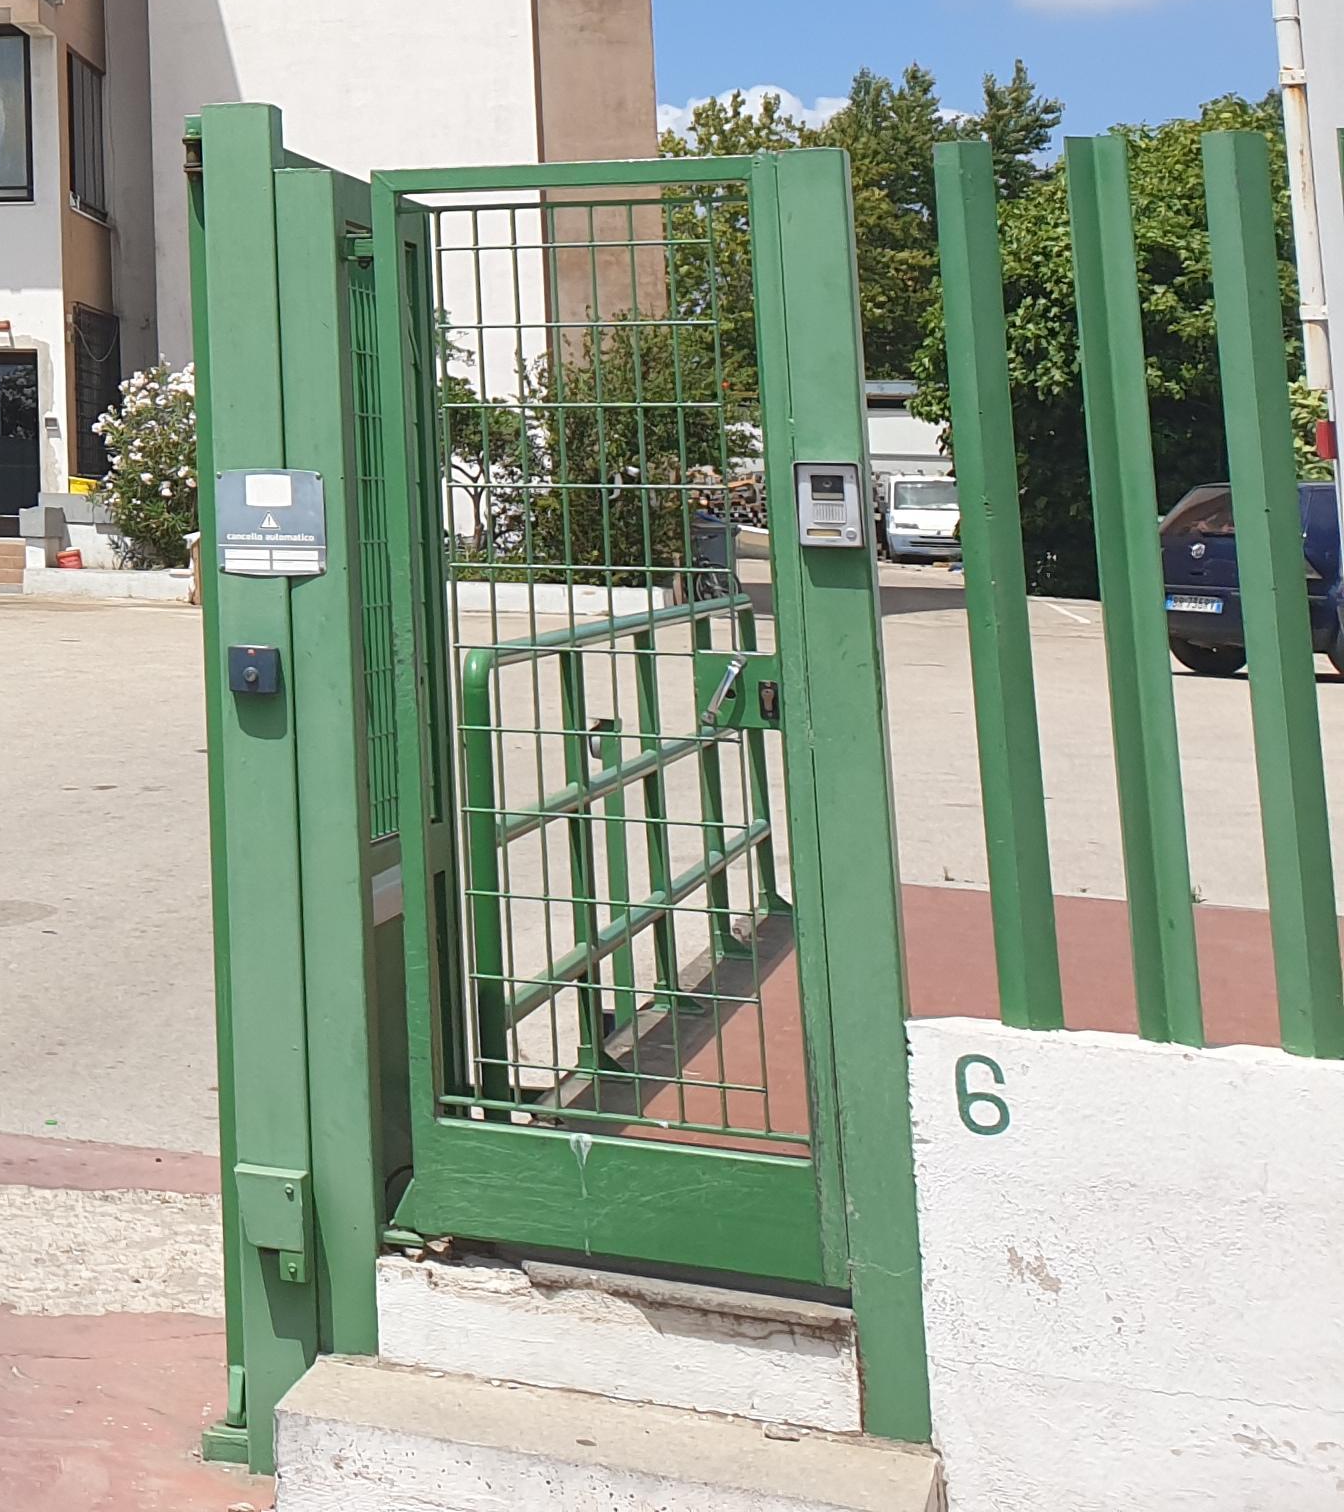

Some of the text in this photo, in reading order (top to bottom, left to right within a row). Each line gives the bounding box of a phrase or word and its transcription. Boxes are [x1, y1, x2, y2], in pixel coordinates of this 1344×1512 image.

[226, 533, 315, 542] cancello automatico
[955, 1053, 1010, 1136] 6
